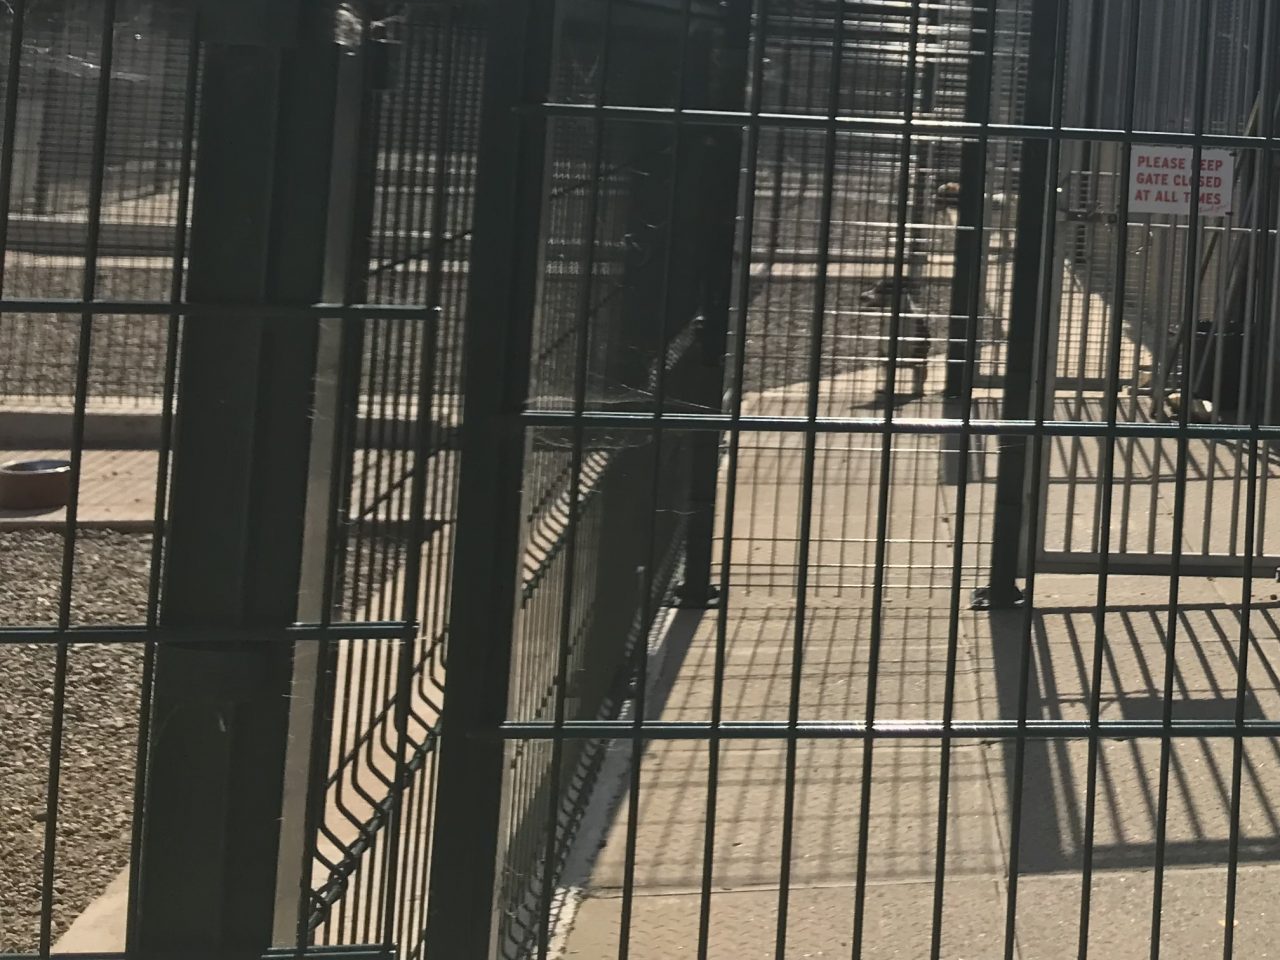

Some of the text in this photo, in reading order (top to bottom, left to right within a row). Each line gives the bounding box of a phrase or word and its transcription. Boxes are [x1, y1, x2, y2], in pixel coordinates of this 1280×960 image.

[1137, 155, 1223, 172] PLEASE EEP
[1136, 172, 1222, 188] GATE CLSED
[1135, 189, 1221, 205] AT ALL TMES
